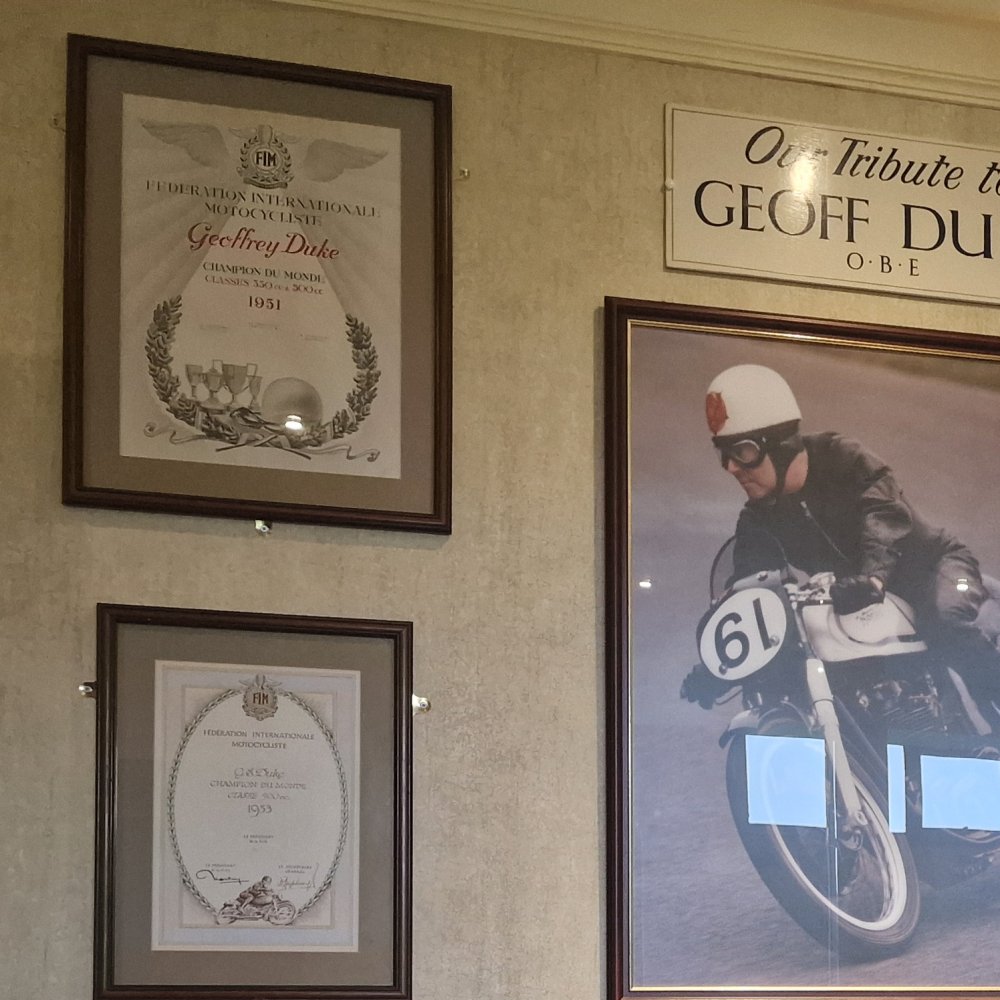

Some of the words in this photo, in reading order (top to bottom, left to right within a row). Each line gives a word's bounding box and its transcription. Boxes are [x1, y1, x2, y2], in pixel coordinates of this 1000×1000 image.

[256, 151, 277, 167] FIM
[832, 137, 965, 190] Tribute
[205, 203, 322, 226] MOTOCYCLISTE
[694, 180, 870, 243] GEOFF
[188, 222, 280, 258] Geoffrey
[282, 232, 340, 259] Duke
[203, 262, 260, 275] CHAMPION
[265, 269, 280, 278] DU
[284, 271, 325, 283] MONDE
[249, 296, 280, 310] 1951
[714, 597, 772, 669] 61
